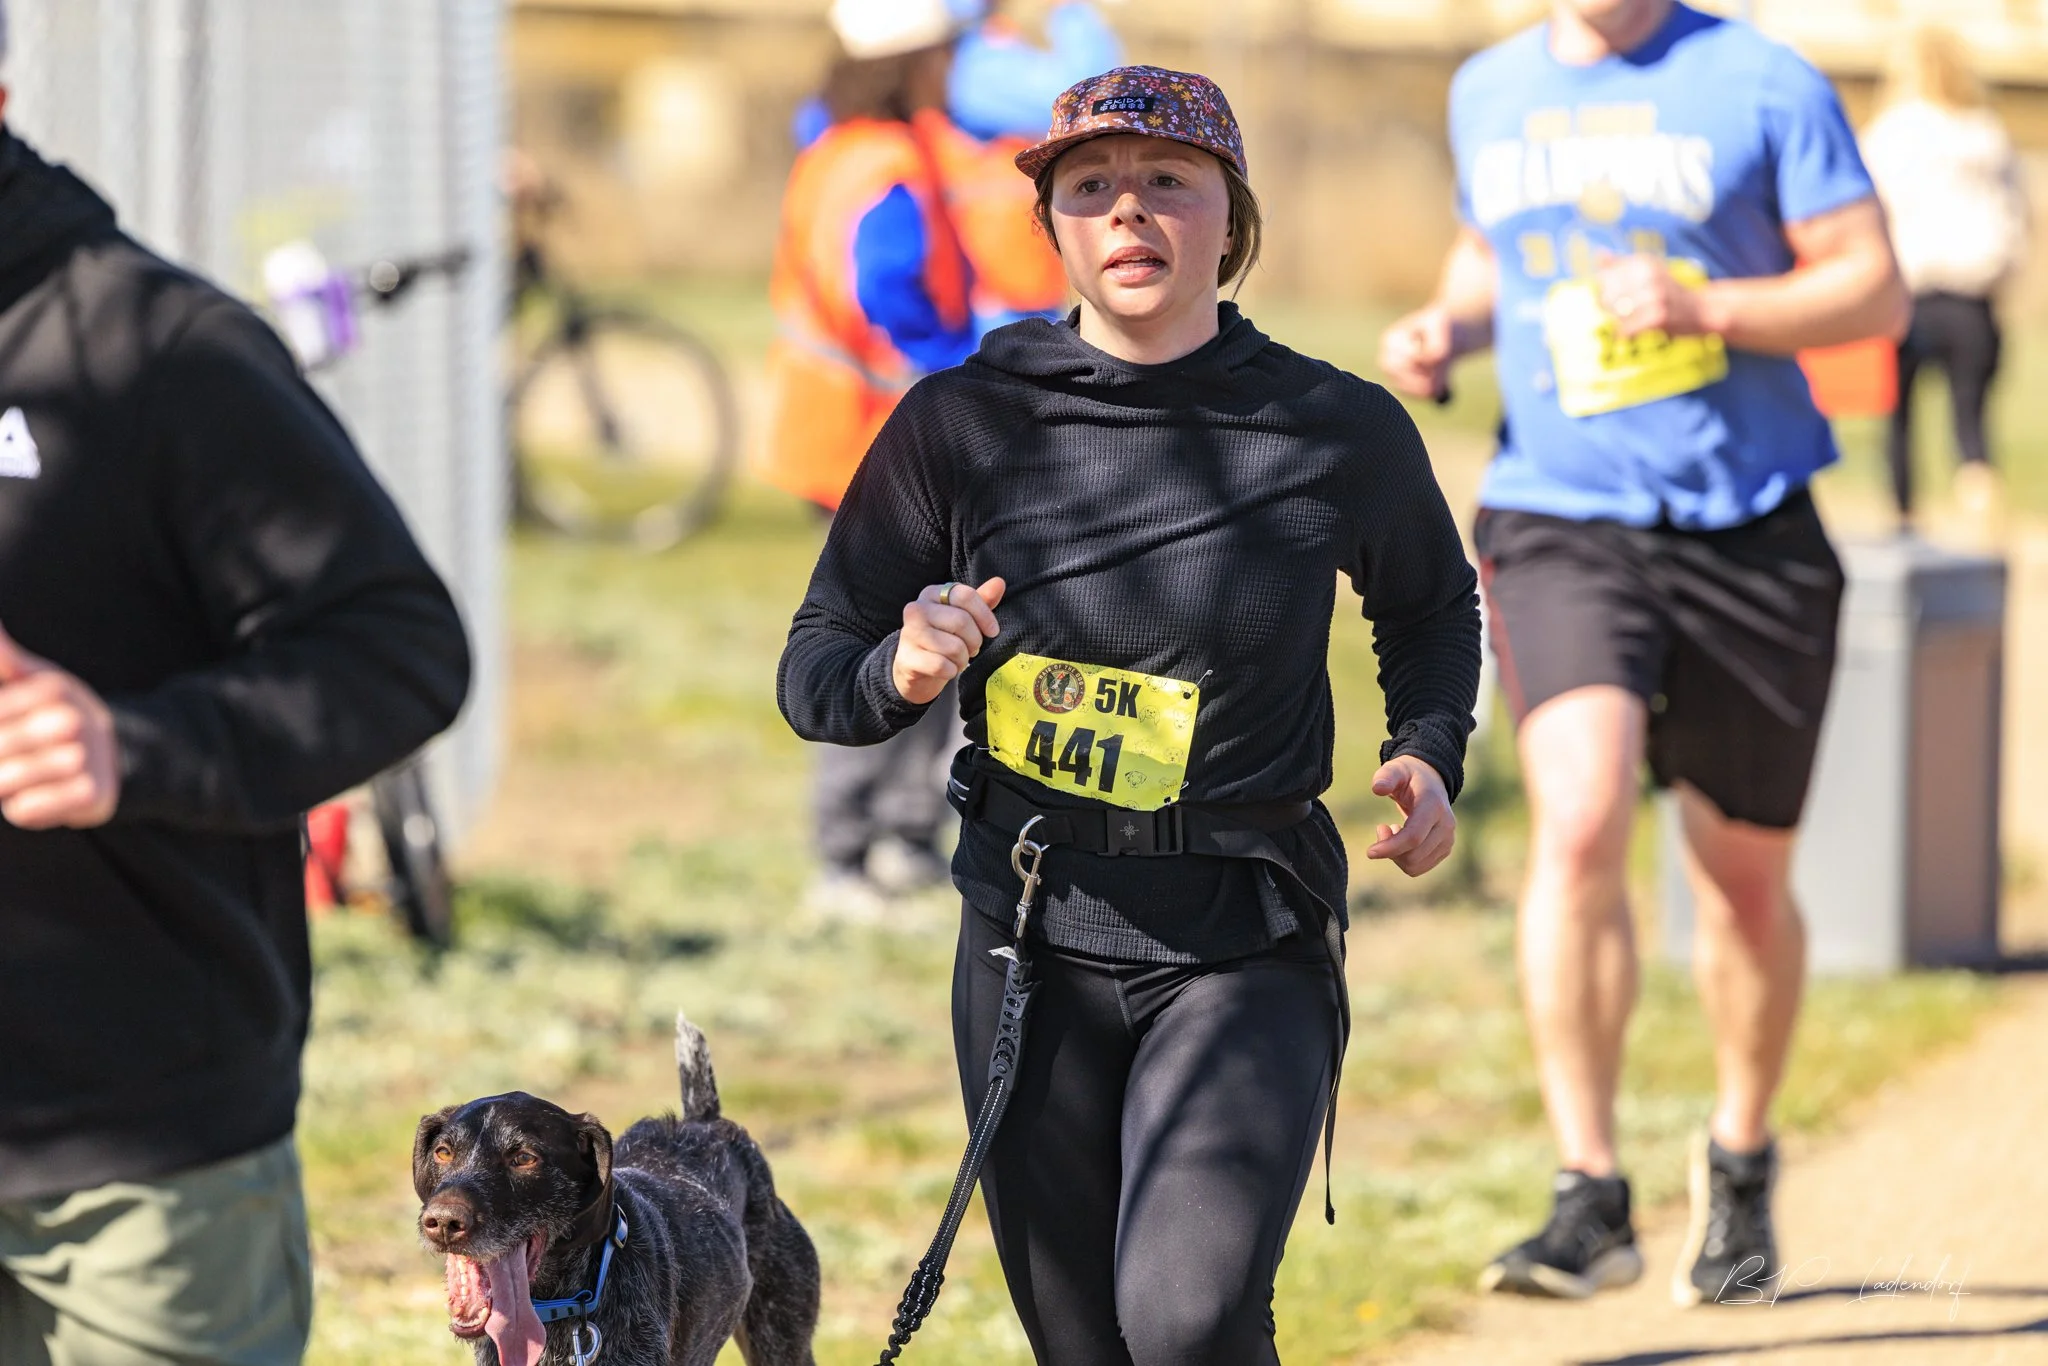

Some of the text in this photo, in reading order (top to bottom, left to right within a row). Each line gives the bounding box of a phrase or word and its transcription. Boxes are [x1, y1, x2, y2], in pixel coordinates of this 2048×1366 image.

[1104, 98, 1144, 106] SKIDA
[1038, 666, 1052, 680] HAIR
[1064, 665, 1075, 673] THE
[1075, 674, 1084, 686] DOG
[1095, 678, 1142, 718] 5K
[1026, 720, 1124, 793] 441
